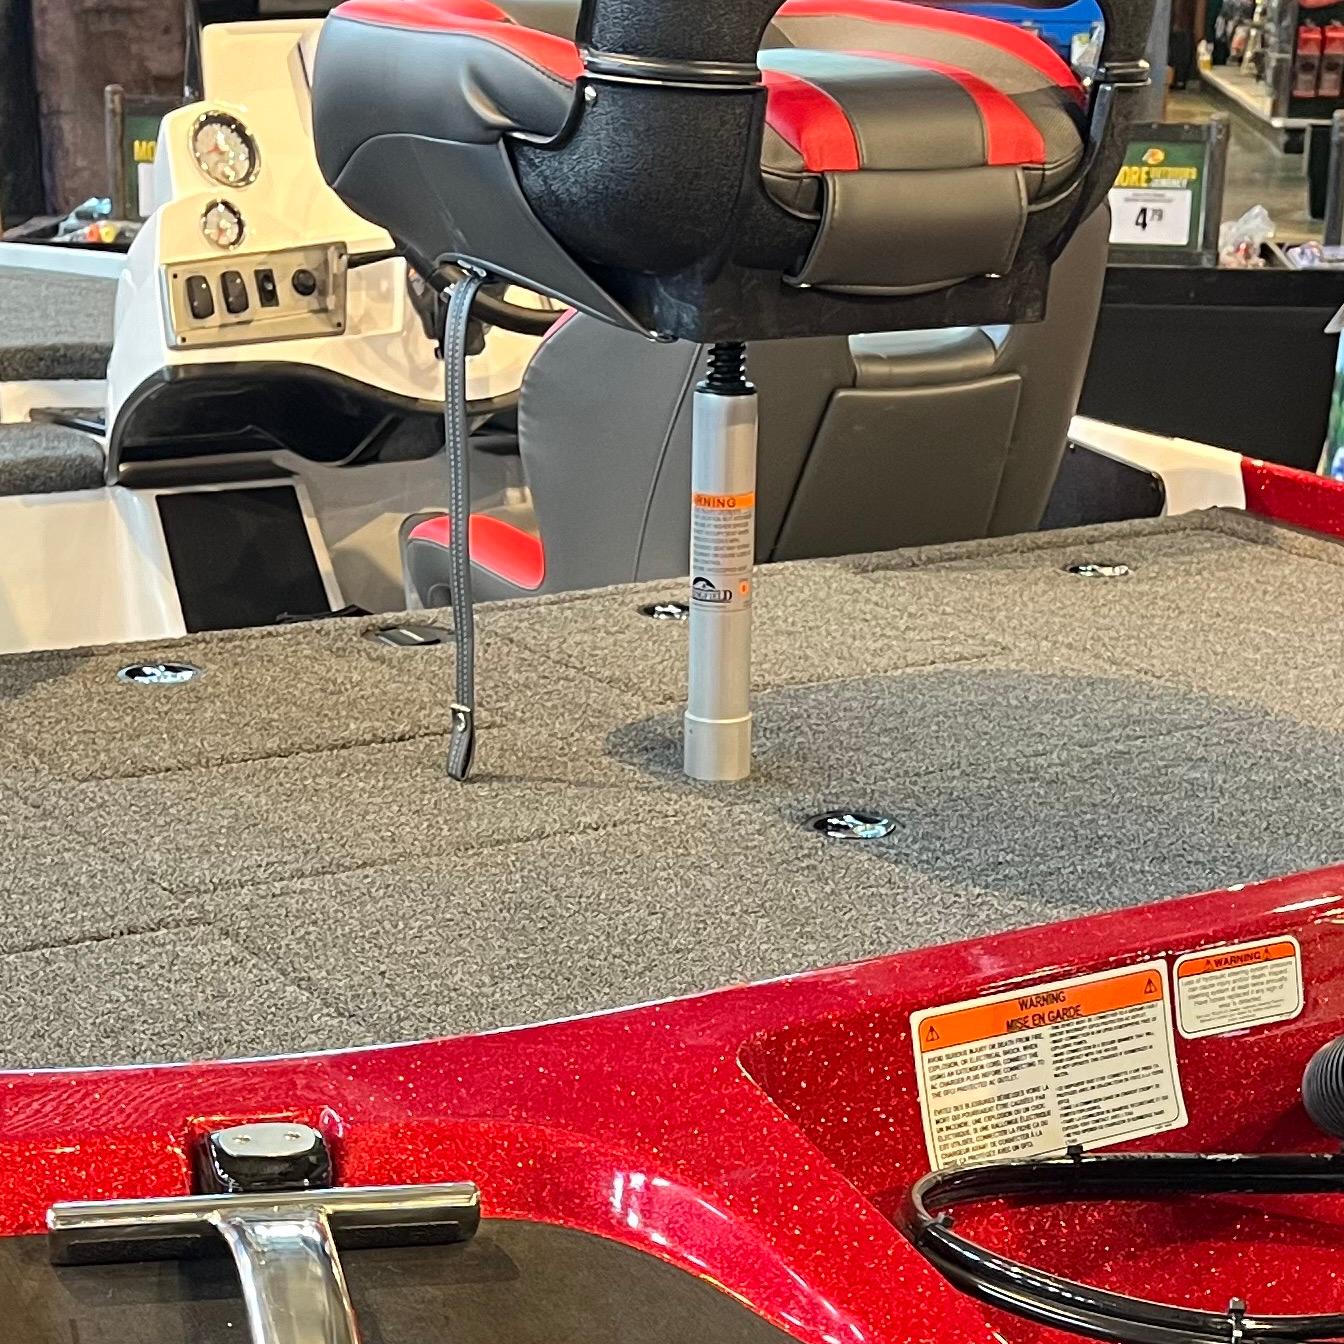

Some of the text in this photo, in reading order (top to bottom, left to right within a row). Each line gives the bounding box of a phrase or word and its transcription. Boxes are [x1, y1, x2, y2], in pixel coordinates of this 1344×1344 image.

[1134, 206, 1148, 231] 4
[1213, 950, 1260, 967] WARNING
[1018, 990, 1065, 1011] WARNING
[1005, 1016, 1030, 1032] MISE
[1031, 1012, 1045, 1026] EN
[1047, 1004, 1081, 1023] GARDE
